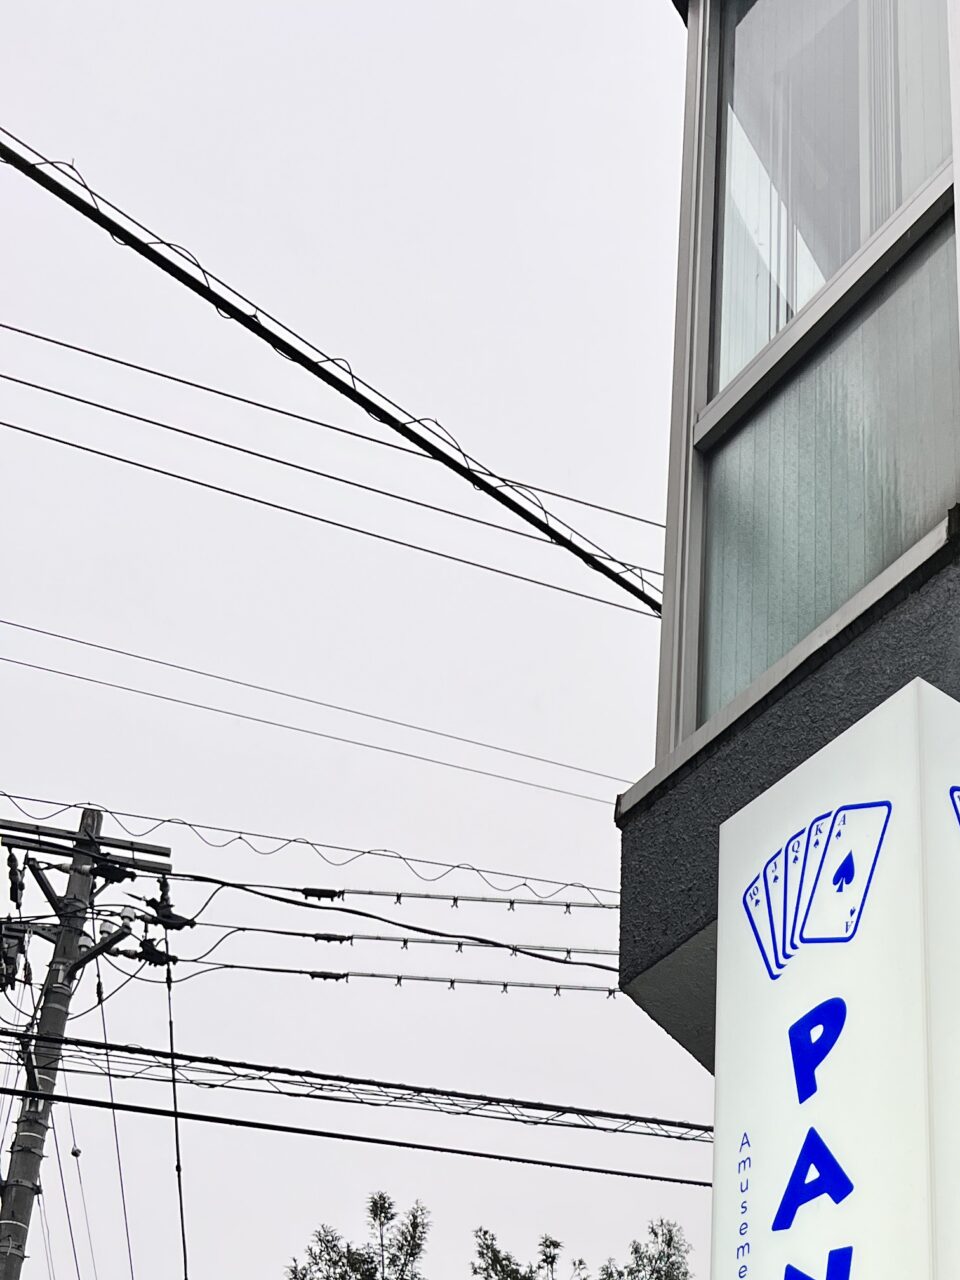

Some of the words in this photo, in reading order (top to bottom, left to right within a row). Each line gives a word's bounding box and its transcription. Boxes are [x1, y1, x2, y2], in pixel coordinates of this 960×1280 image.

[749, 886, 759, 900] 10
[771, 862, 778, 873] J
[791, 840, 801, 854] Q
[814, 822, 824, 836] K
[837, 813, 847, 826] A
